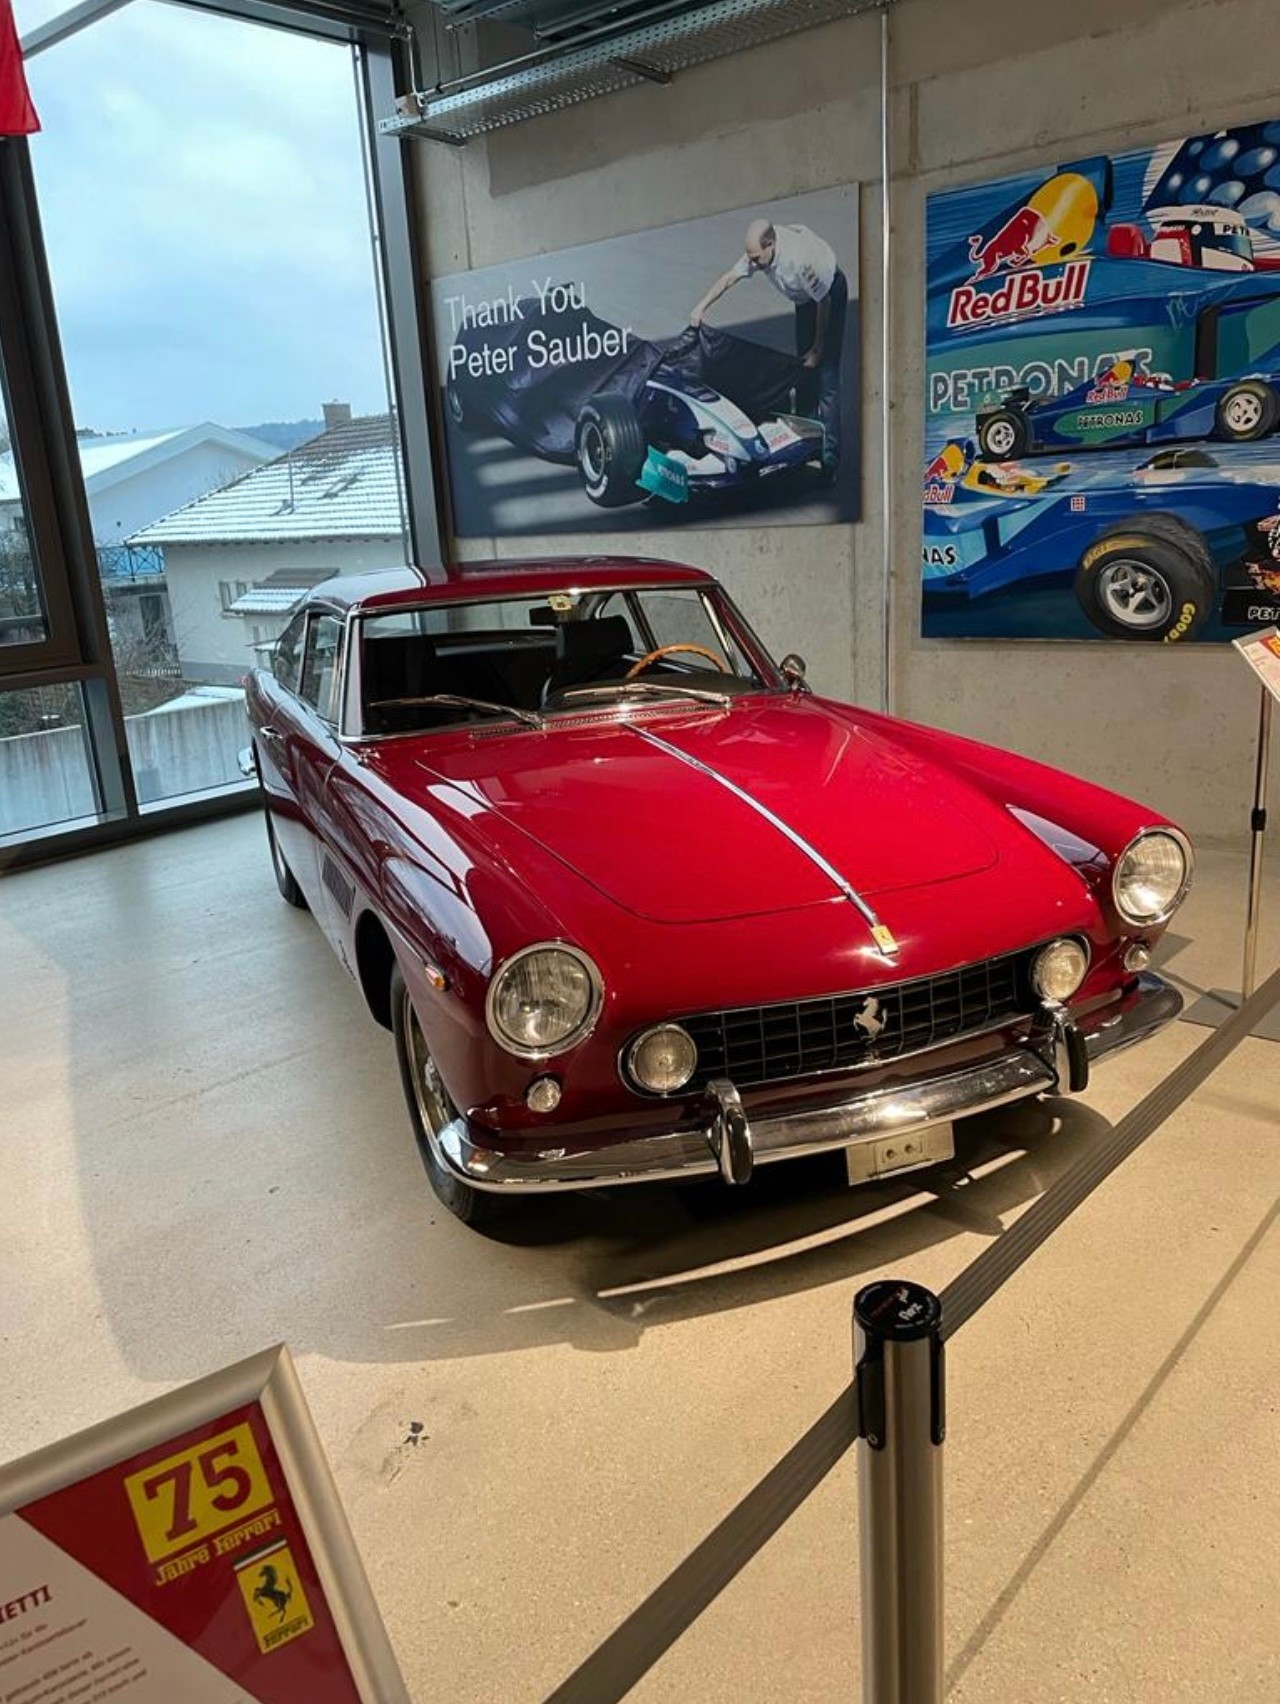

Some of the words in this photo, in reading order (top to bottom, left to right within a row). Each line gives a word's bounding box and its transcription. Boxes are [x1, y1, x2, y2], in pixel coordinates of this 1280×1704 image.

[444, 285, 525, 332] Thank
[532, 277, 586, 317] You
[449, 344, 519, 380] Peter
[527, 323, 634, 369] Sauber
[1078, 410, 1144, 429] PETRONAS
[144, 1440, 252, 1542] 75
[155, 1546, 210, 1587] Jahre
[214, 1508, 283, 1556] Ferrari
[263, 1616, 310, 1648] Ferrari
